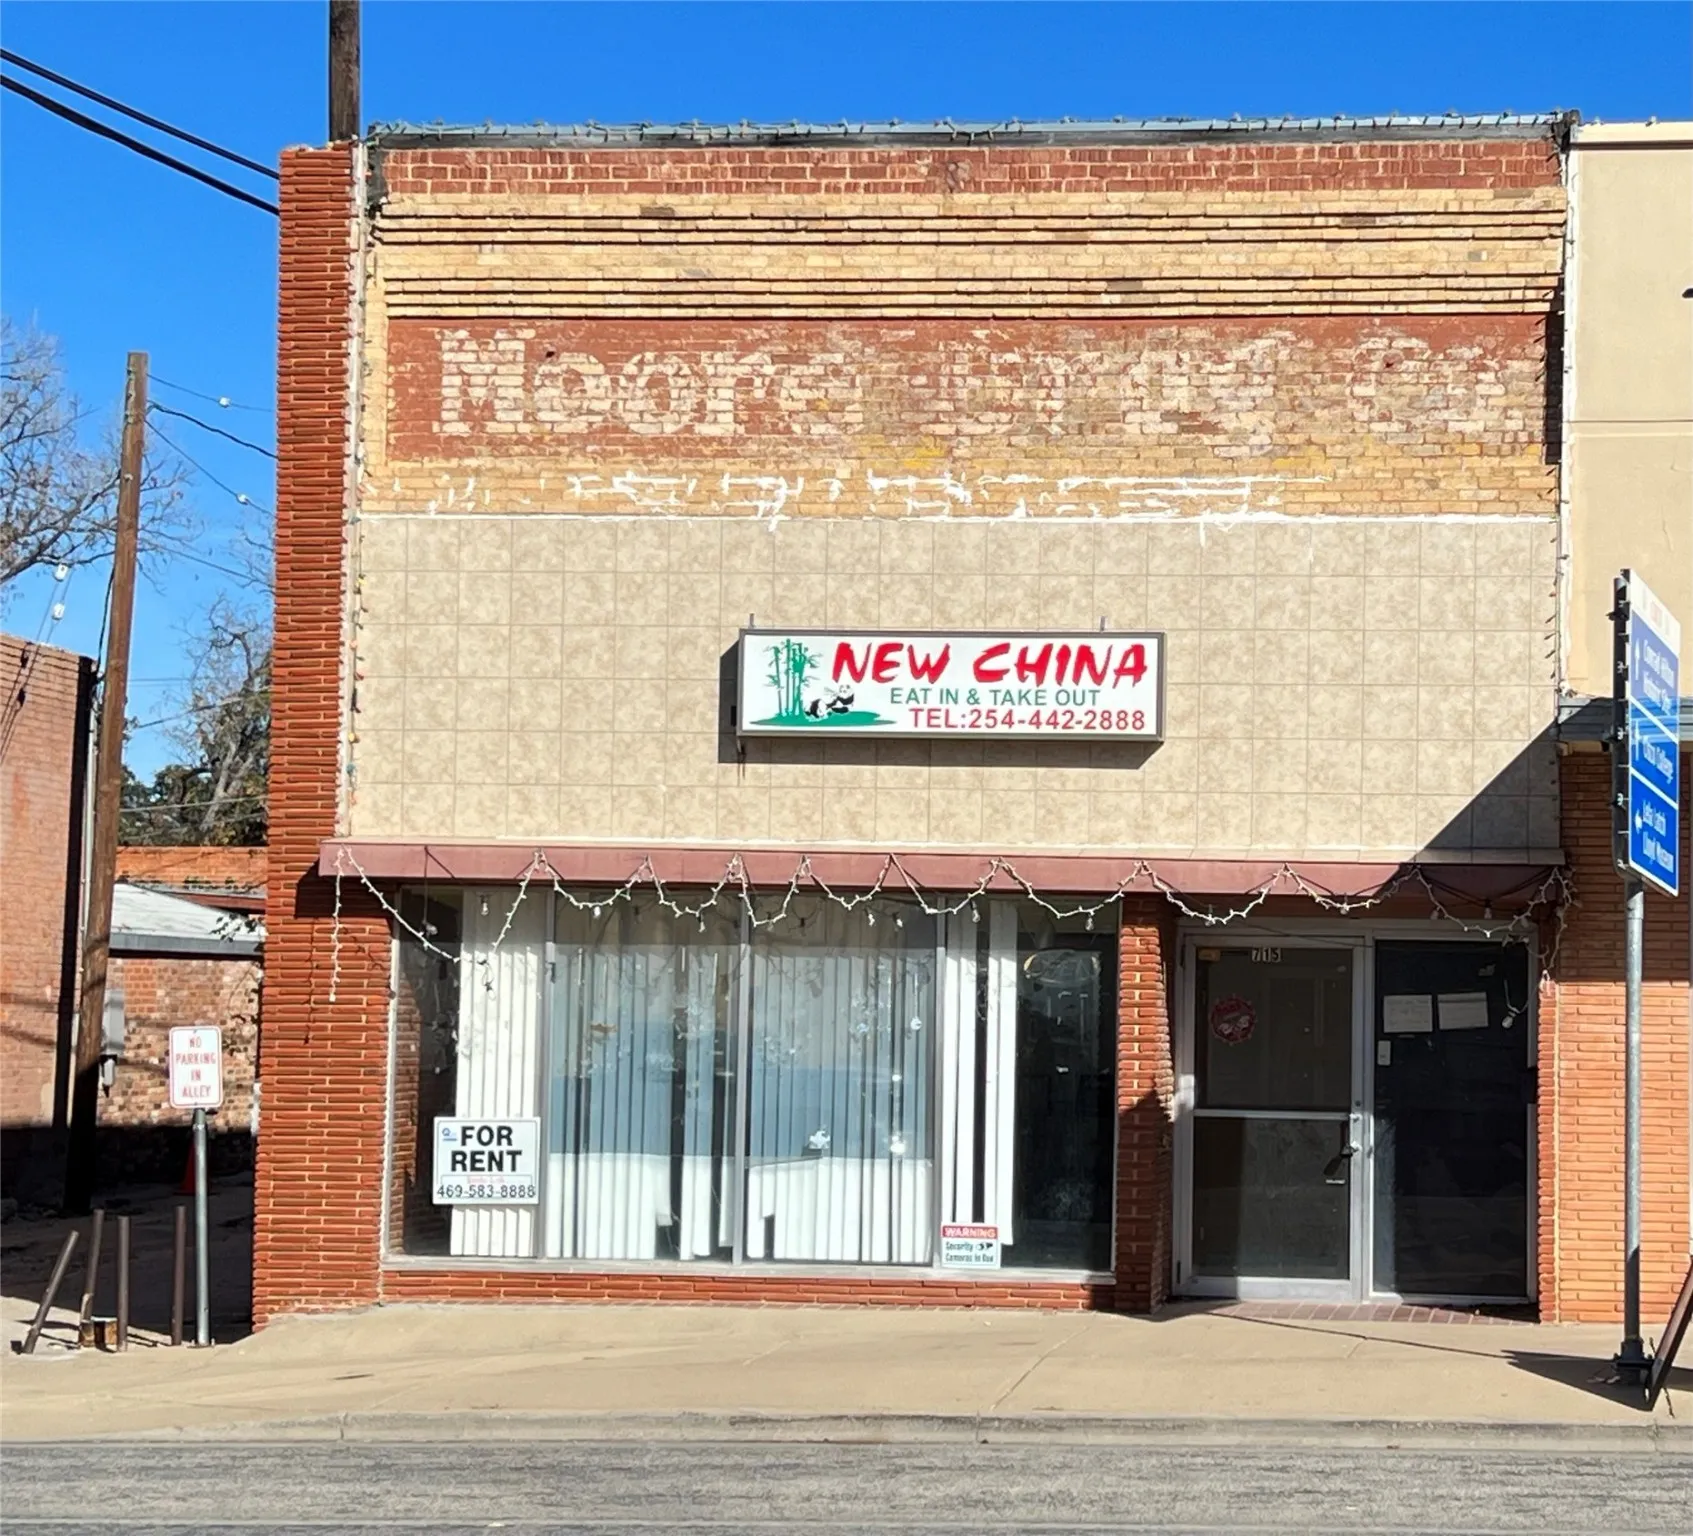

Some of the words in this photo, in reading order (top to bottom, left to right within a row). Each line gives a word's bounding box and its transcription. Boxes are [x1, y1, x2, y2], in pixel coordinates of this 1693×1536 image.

[832, 642, 951, 684] NEW
[973, 642, 1148, 689] CHINA
[890, 687, 932, 705] EAT
[939, 688, 959, 705] IN
[966, 688, 981, 705] &
[989, 688, 1048, 706] TAKE
[1055, 689, 1101, 706] OUT
[908, 708, 1145, 731] TEL:254-442-2888
[1252, 947, 1280, 962] 715
[189, 1036, 202, 1048] NO
[175, 1052, 216, 1065] PARKING
[191, 1069, 201, 1081] IN
[182, 1085, 211, 1098] ALLEY
[461, 1125, 513, 1147] FOR
[451, 1150, 522, 1172] RENT
[437, 1184, 536, 1198] 469-583-8888
[944, 1227, 996, 1238] WARNING
[945, 1241, 973, 1252] Security
